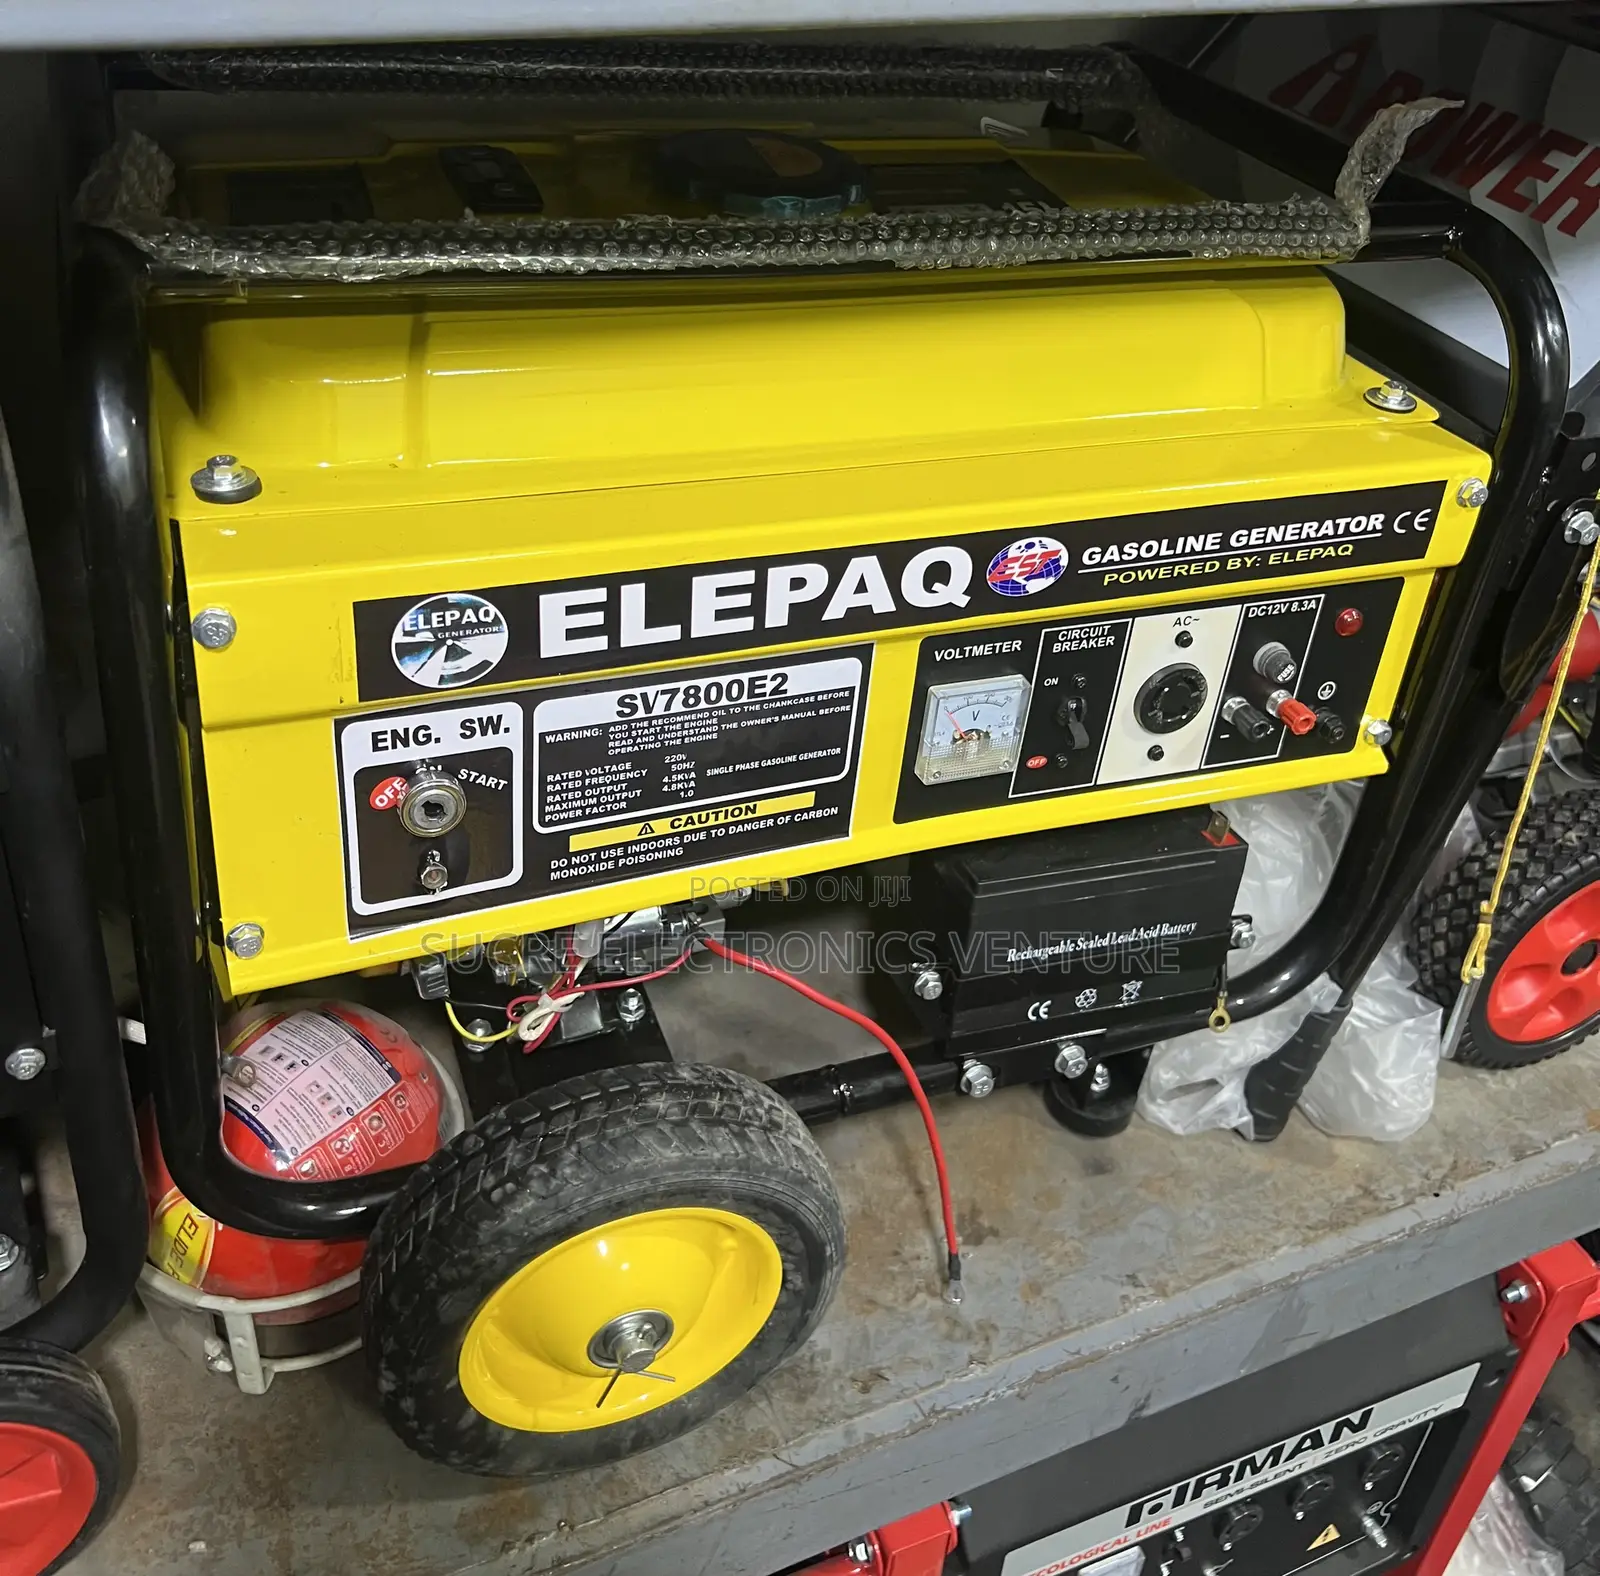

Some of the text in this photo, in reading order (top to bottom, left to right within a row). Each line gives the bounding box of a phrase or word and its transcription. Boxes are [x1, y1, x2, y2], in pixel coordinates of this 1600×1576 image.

[1082, 508, 1432, 566] GASOLINE GENERATOR CE
[987, 548, 1063, 583] EST
[1103, 543, 1354, 586] POWERED BY: ELEPAQ
[539, 546, 973, 658] ELEPAQ
[1248, 599, 1316, 618] DC12V 8.3A
[403, 606, 497, 632] ELEPAQ
[1058, 625, 1111, 641] CIRCUIT
[934, 640, 1022, 661] VOLTMETER
[1052, 636, 1115, 653] BREAKER
[1044, 677, 1059, 687] ON
[1277, 663, 1295, 682] FUSE
[608, 724, 628, 733] ADD
[631, 721, 649, 730] THE
[652, 711, 709, 727] RECOMMEND
[712, 709, 727, 718] OIL
[729, 706, 741, 715] TO
[744, 704, 761, 712] THE
[817, 690, 850, 702] BEFORE
[615, 672, 789, 719] SV7800E2
[608, 705, 851, 749] READ AND UNDERSTAND THE OWNER'S MANUAL BEFORE
[609, 717, 718, 740] YOU START THE ENGINE
[972, 709, 981, 721] V
[371, 714, 511, 752] ENG. SW.
[545, 728, 603, 744] WARNING:
[608, 732, 718, 756] OPERATING THE ENGINE
[546, 769, 583, 783] RATED
[585, 762, 632, 778] VOLTAGE
[546, 761, 696, 793] RATED FREQUENCY 50HZ
[706, 747, 841, 777] SINGLE PHASE GASOLINE GENERATOR
[1027, 756, 1047, 767] OFF
[457, 768, 508, 791] START
[546, 772, 697, 804] RATED OUTPUT 4.5KVA
[545, 781, 696, 813] MAXIMUM OUTPUT 4.8KVA
[545, 789, 694, 823] POWER FACTOR 1.0
[669, 803, 758, 830] CAUTION
[550, 806, 839, 870] DO NOT USE INDOORS DUE TO DANGER OF CARBON
[550, 847, 684, 881] MONOXIDE POISONING
[1006, 921, 1198, 963] Rechargeable Sealed Lead Acid Battery
[170, 1212, 200, 1269] ELIDE
[1125, 1406, 1375, 1529] FIRMAN
[1203, 1403, 1445, 1509] SEMI-SILENT ZERO GRAVITY
[1135, 1515, 1173, 1539] LINE
